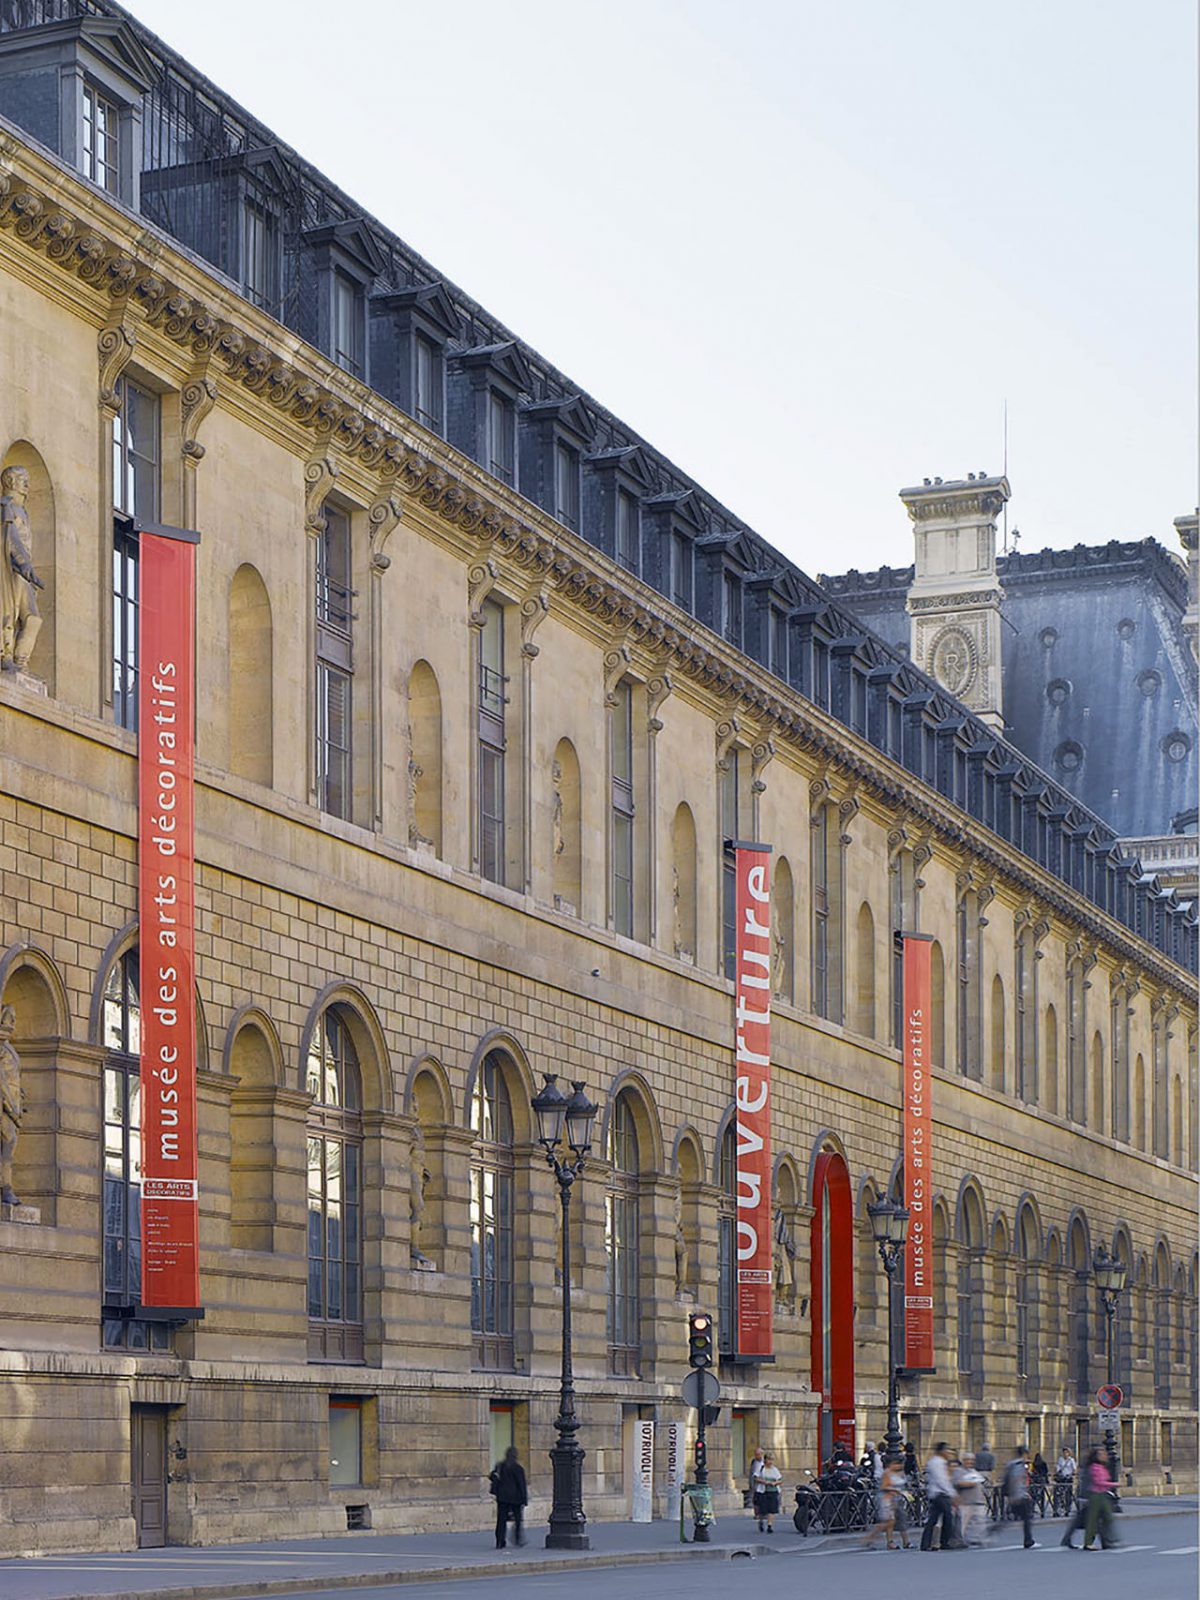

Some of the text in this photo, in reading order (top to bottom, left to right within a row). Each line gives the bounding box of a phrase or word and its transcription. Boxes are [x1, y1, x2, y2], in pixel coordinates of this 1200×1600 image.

[152, 662, 178, 1160] musée des arts décoratifs
[737, 866, 770, 1260] ouverture
[909, 1008, 923, 1117] décoratifs
[910, 1128, 923, 1169] arts
[910, 1179, 923, 1212] des
[910, 1221, 924, 1286] musée
